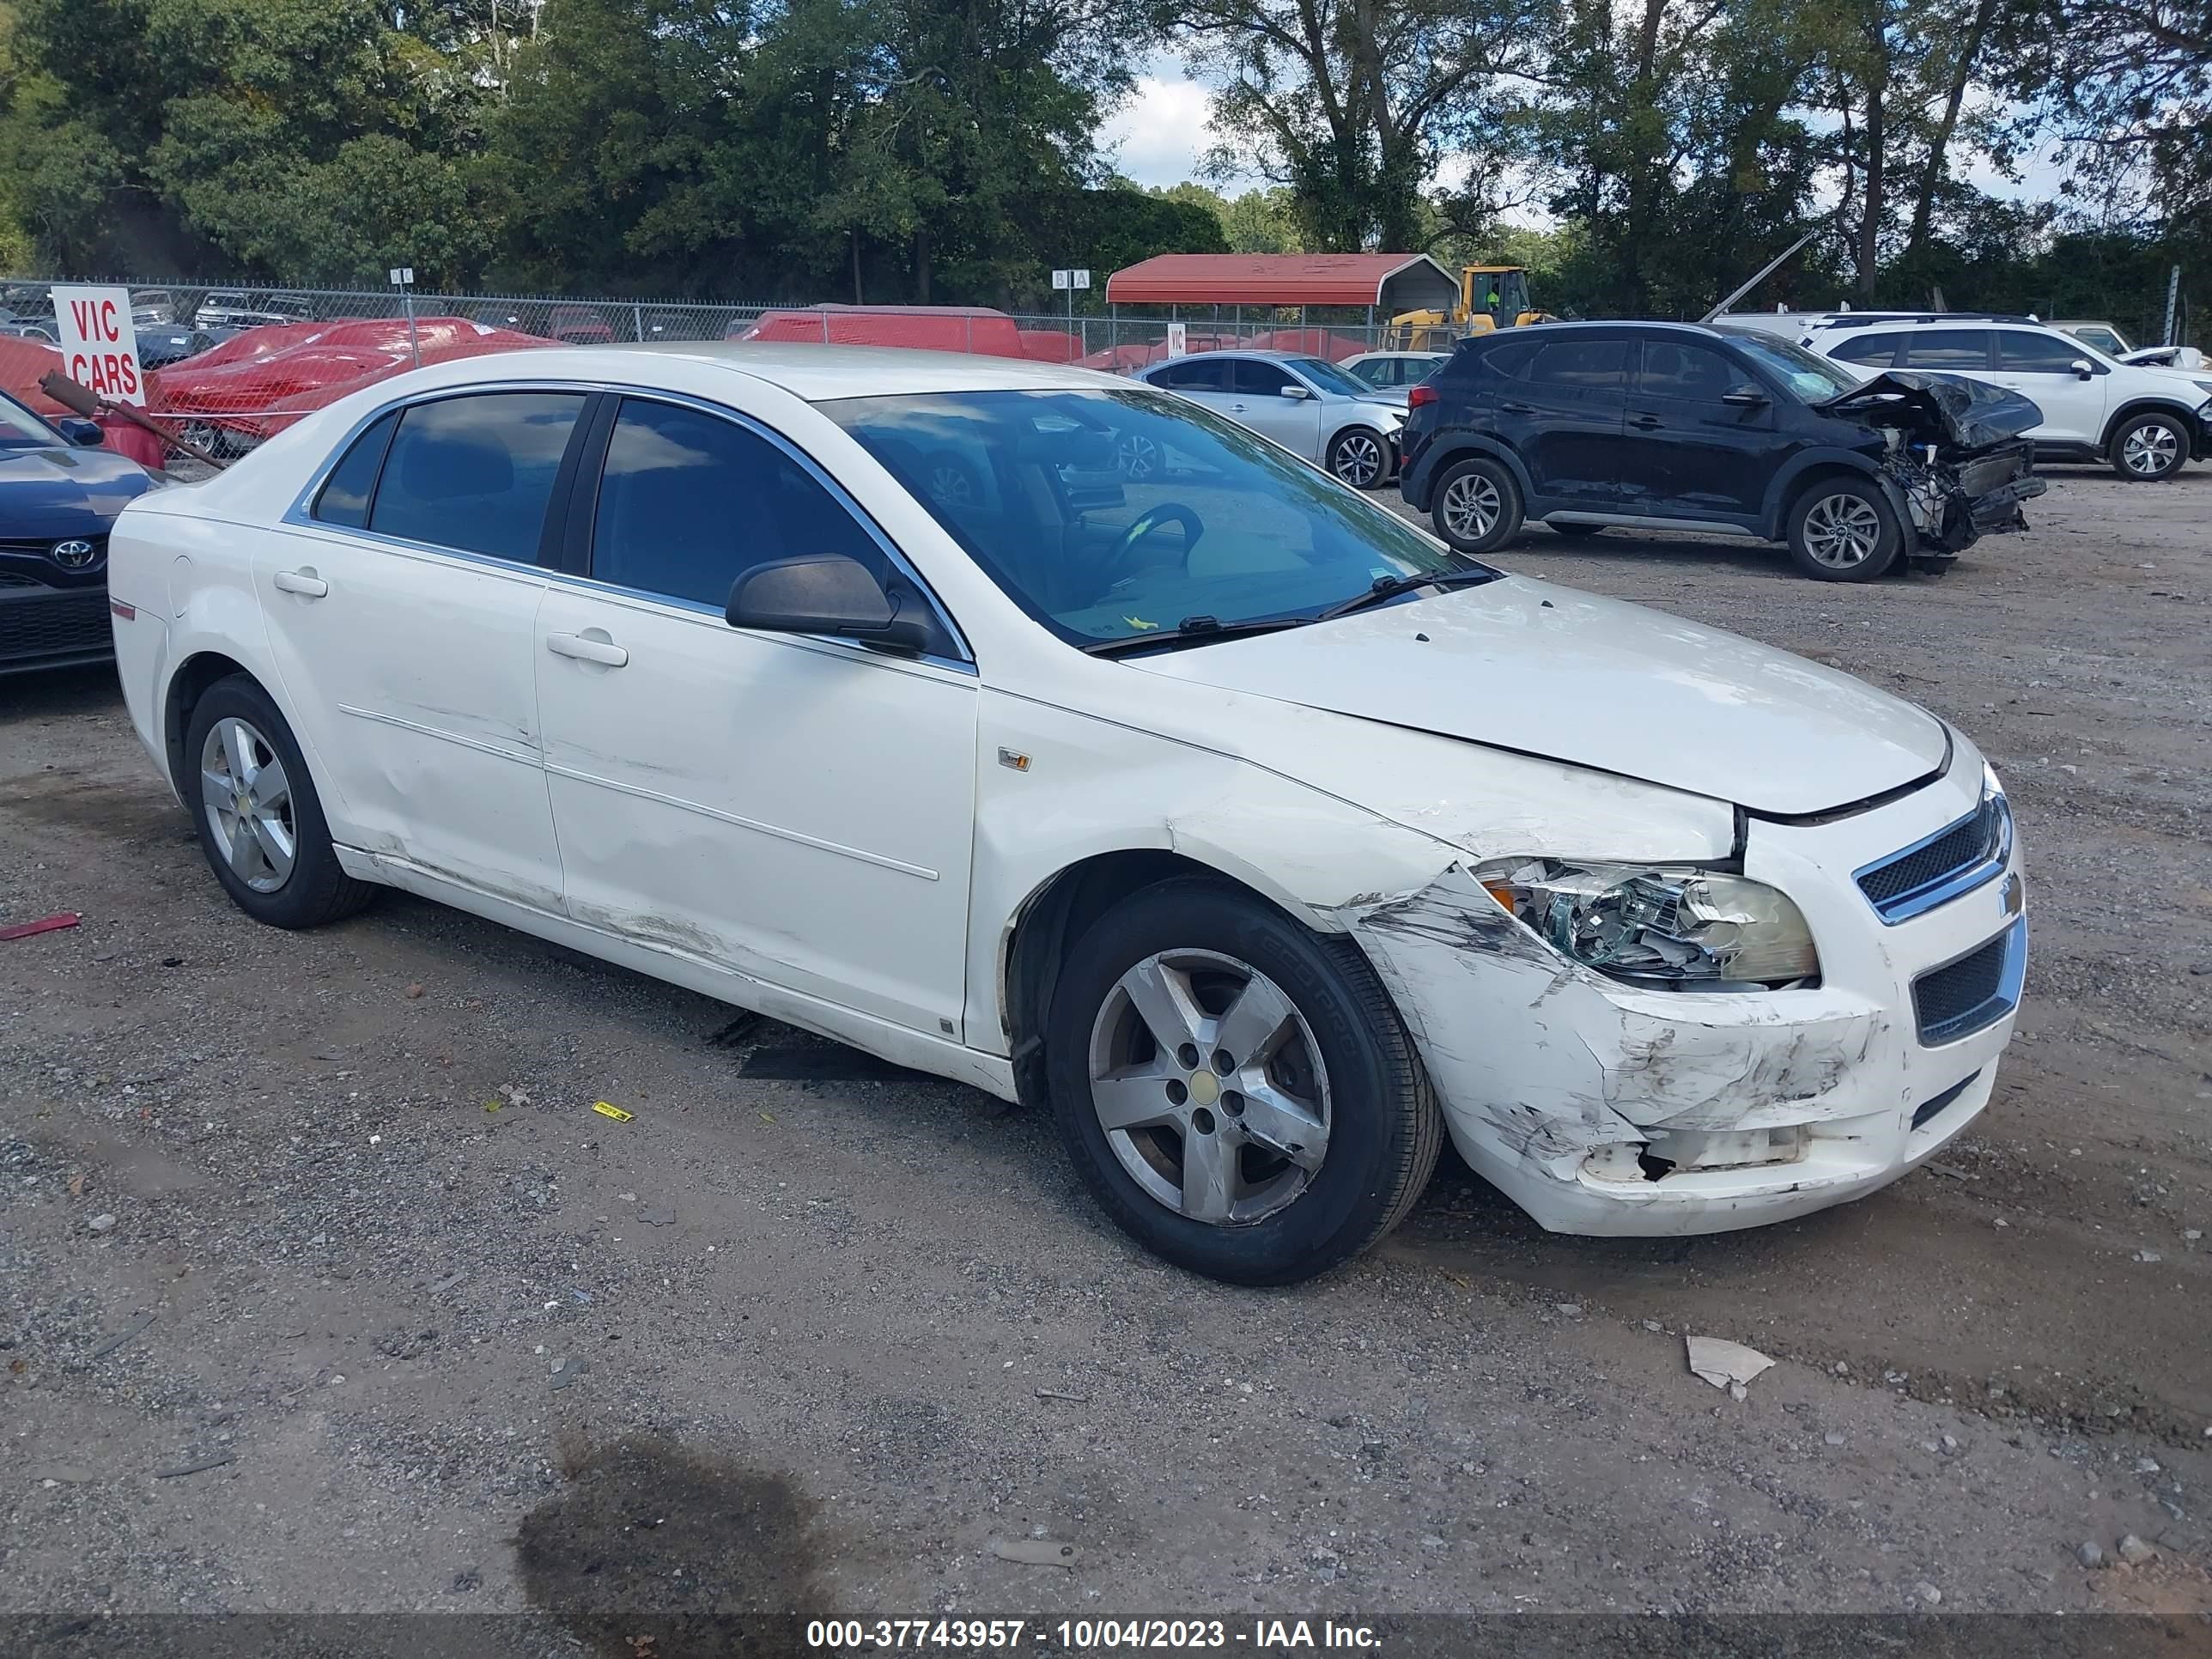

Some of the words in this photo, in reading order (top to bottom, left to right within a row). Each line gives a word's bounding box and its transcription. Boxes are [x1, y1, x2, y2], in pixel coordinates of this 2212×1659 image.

[1055, 272, 1065, 287] B
[1076, 272, 1087, 286] A
[70, 301, 118, 342] VIC
[1171, 330, 1182, 350] VIC
[72, 353, 137, 395] CARS
